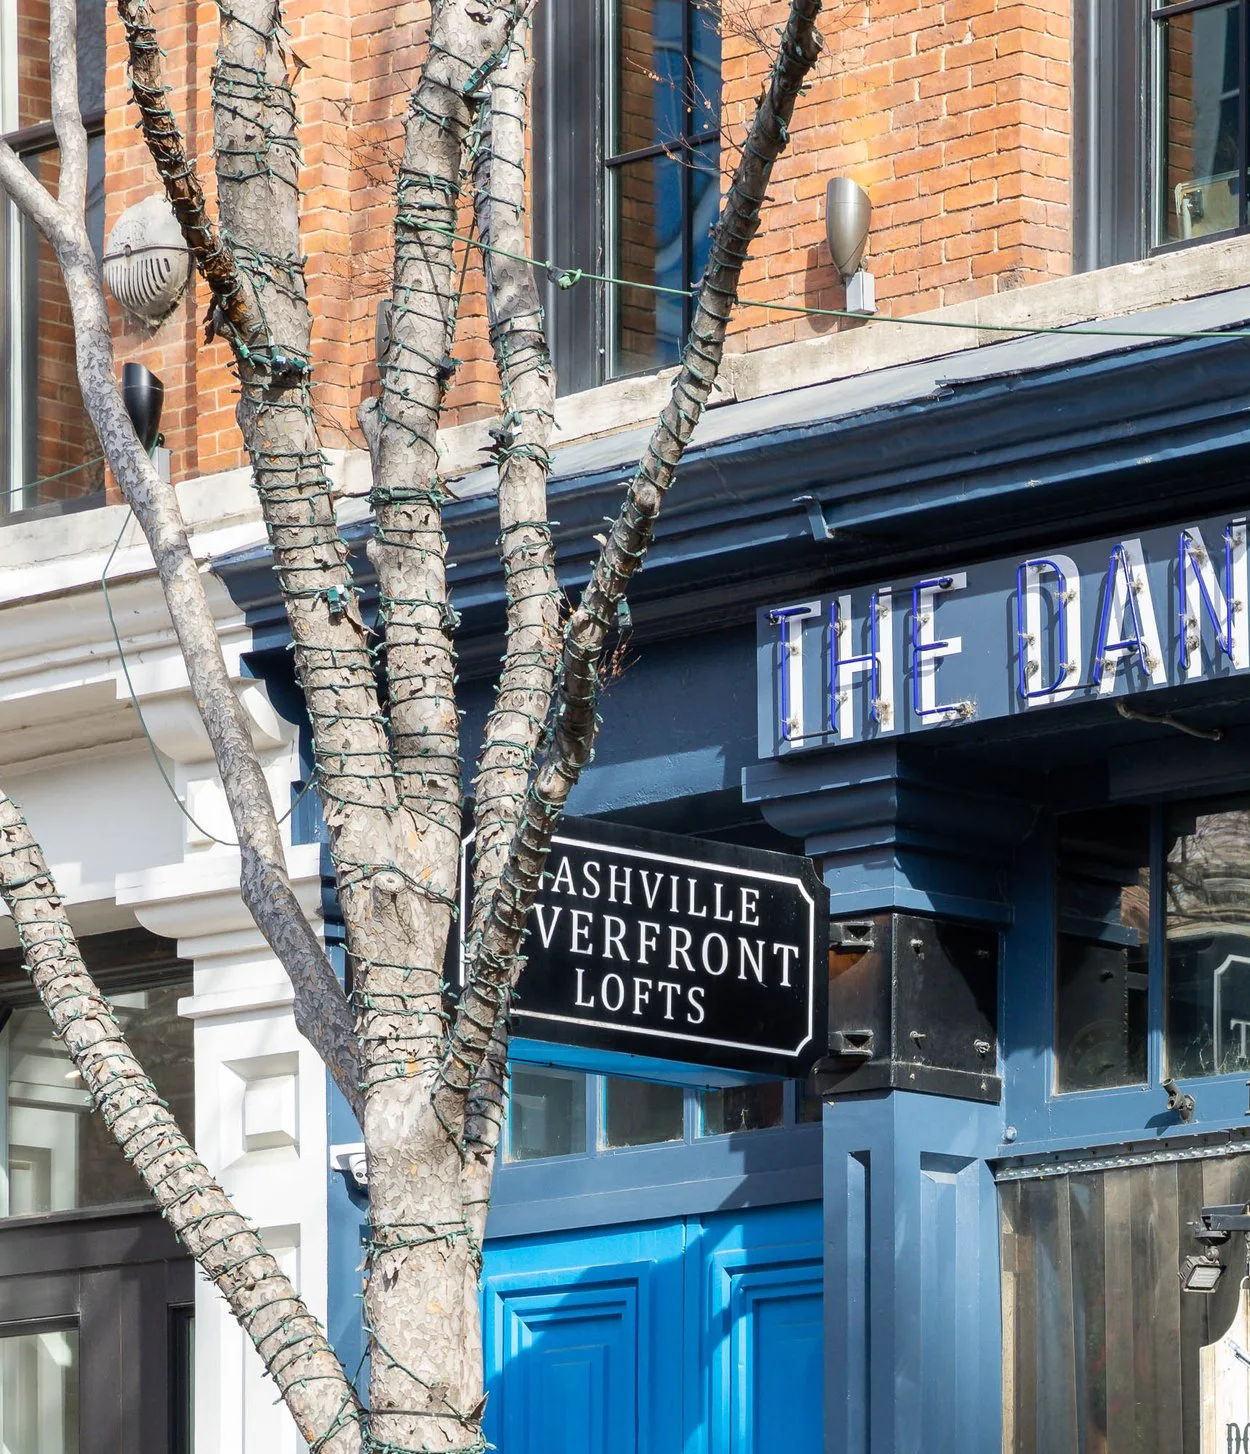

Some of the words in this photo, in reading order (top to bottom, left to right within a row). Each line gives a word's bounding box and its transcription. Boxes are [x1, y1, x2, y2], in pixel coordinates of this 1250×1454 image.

[766, 572, 976, 748] THE
[538, 856, 760, 927] ASHVILLE
[533, 903, 799, 988] VERFRONT
[574, 967, 706, 1025] LOFTS
